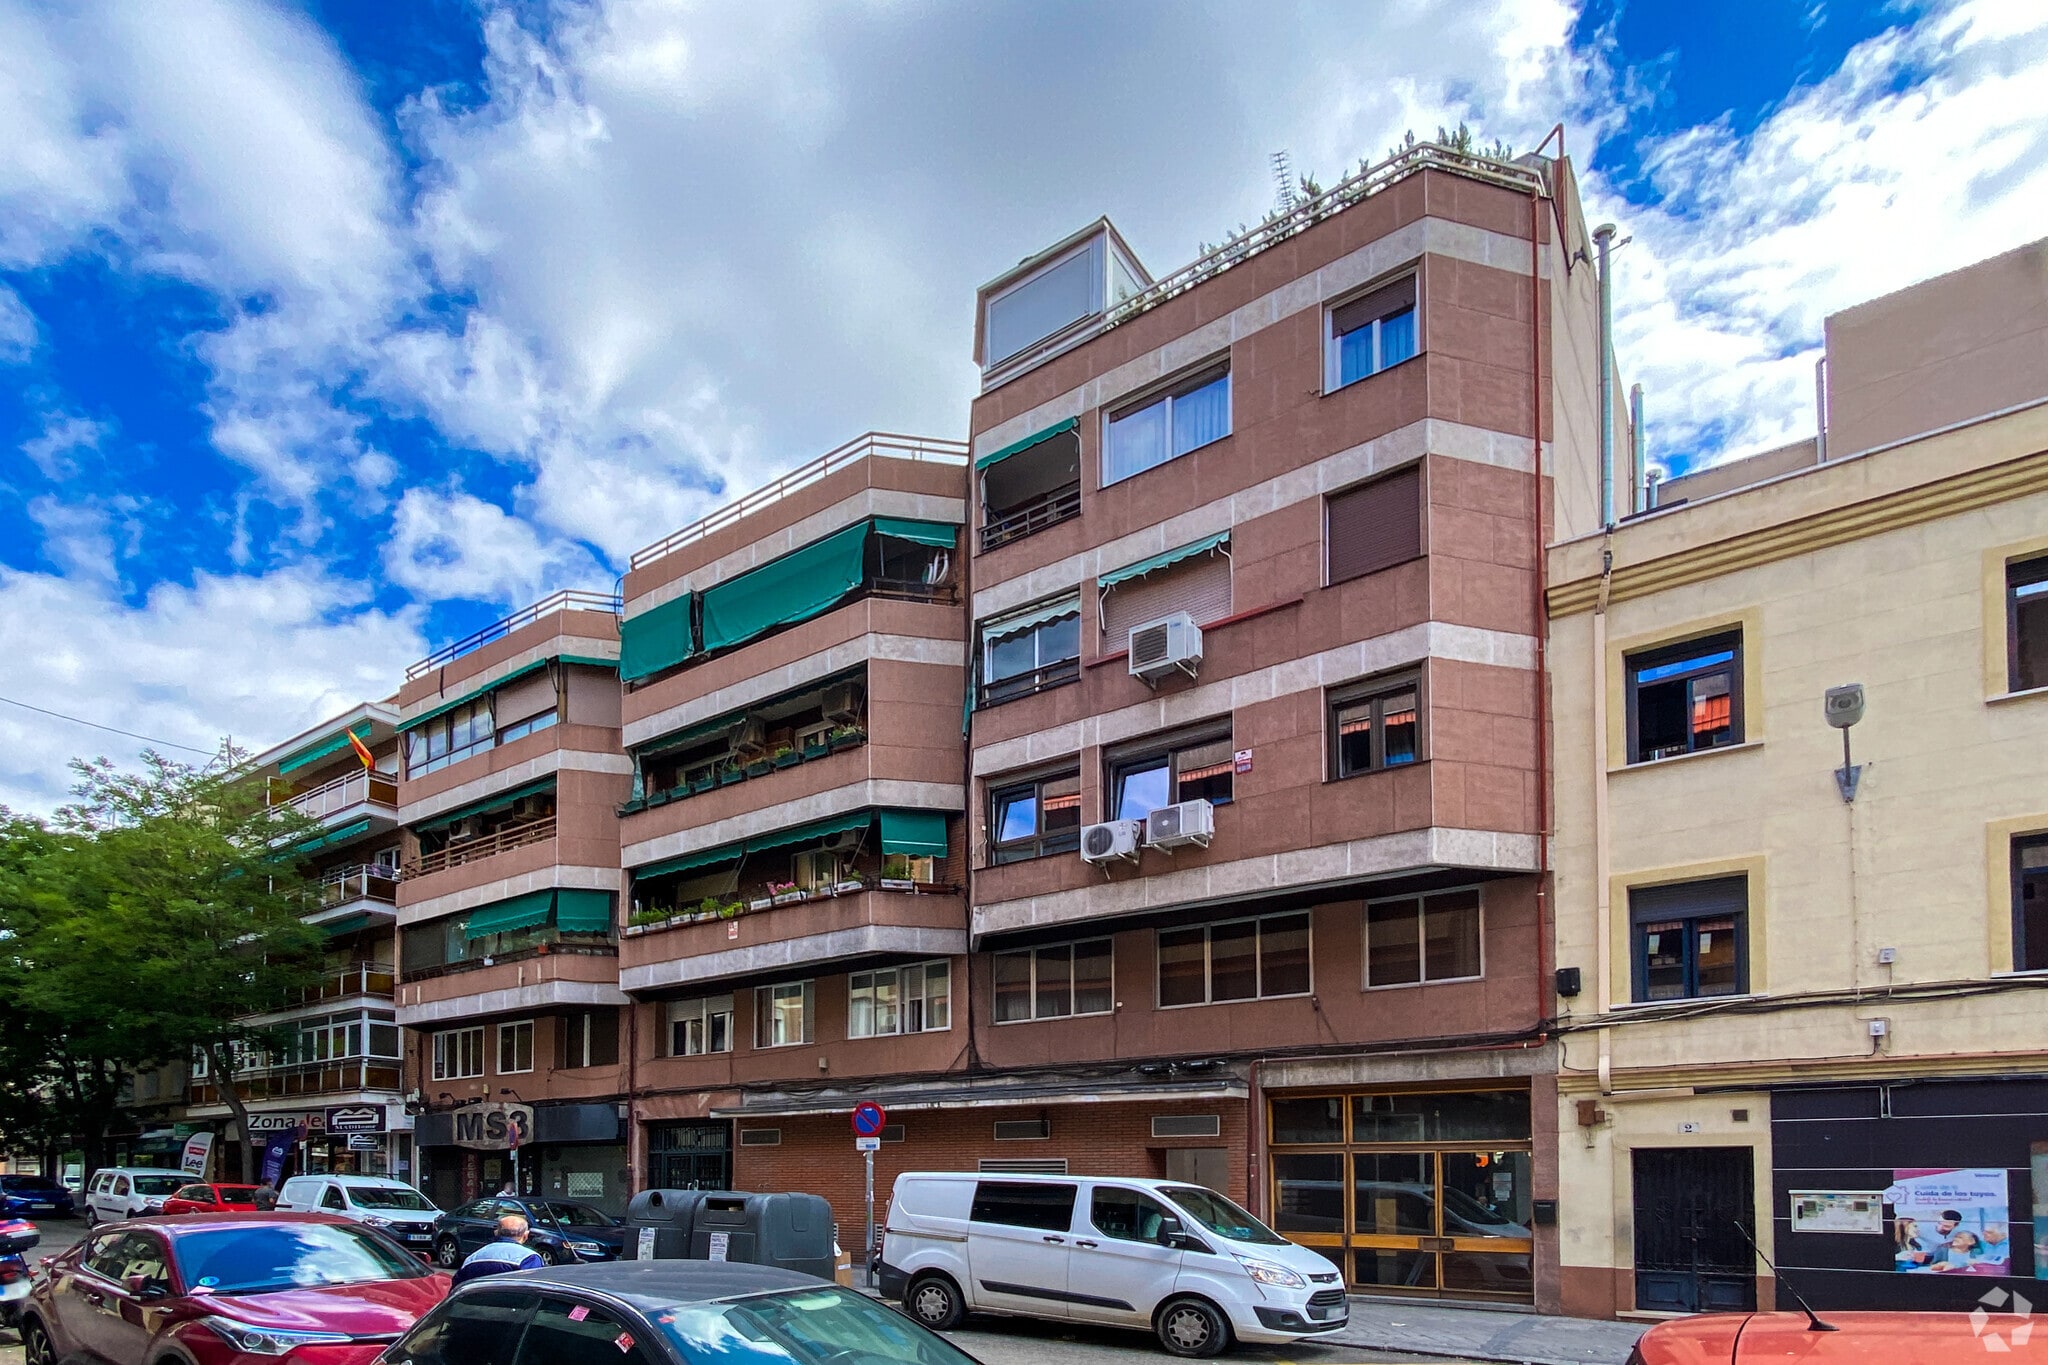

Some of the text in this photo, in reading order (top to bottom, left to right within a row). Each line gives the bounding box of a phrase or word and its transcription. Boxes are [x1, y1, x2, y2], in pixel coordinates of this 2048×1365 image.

[249, 1113, 325, 1129] Zona Je
[457, 1111, 528, 1140] MS3
[1684, 1123, 1692, 1133] 2
[185, 1156, 203, 1168] Lee
[1969, 1190, 1997, 1198] tuyos.
